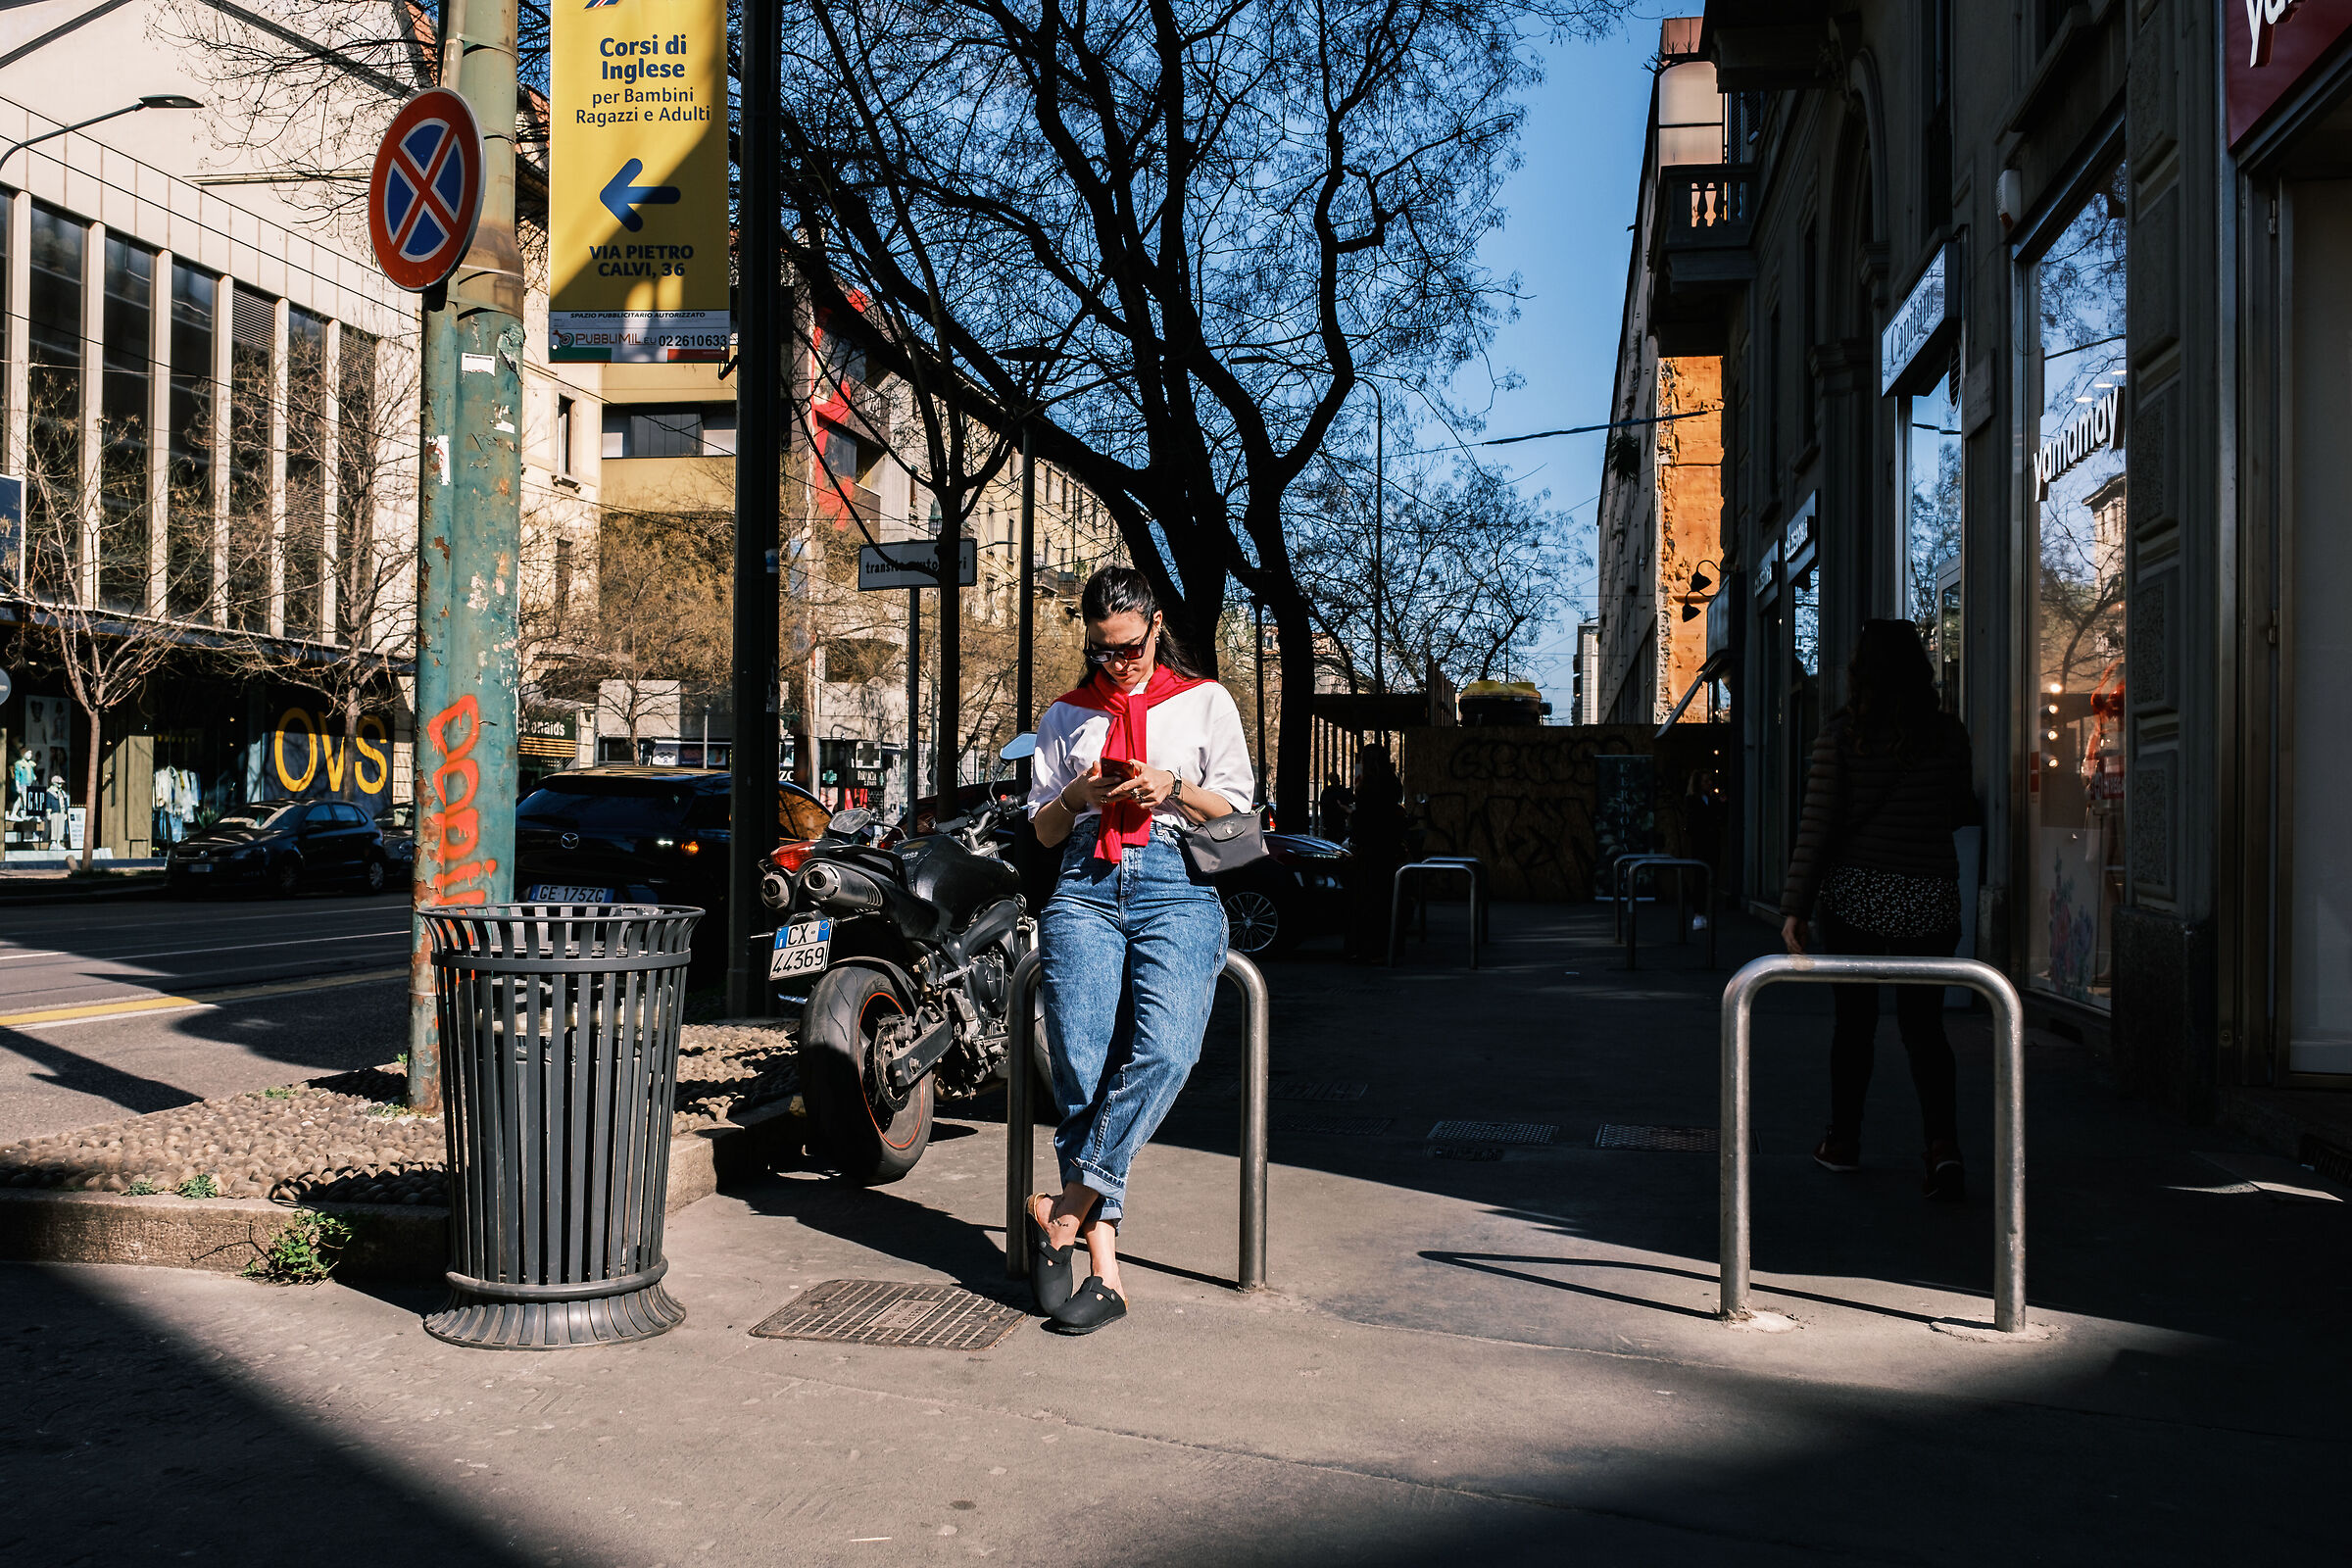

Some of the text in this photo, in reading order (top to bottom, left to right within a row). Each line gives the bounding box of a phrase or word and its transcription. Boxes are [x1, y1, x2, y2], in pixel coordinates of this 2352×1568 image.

[600, 34, 687, 57] Corsi di
[602, 58, 685, 85] Inglese
[593, 86, 694, 109] per Bambini
[576, 105, 710, 127] Ragazzi e Adulti
[589, 245, 694, 260] VIA PIETRO
[598, 263, 685, 278] CALVI, 36
[2034, 386, 2119, 502] yamamay
[274, 708, 388, 795] OVS
[27, 791, 45, 811] GAP
[539, 886, 559, 901] GE
[788, 924, 809, 946] CX
[772, 947, 825, 973] 44369
